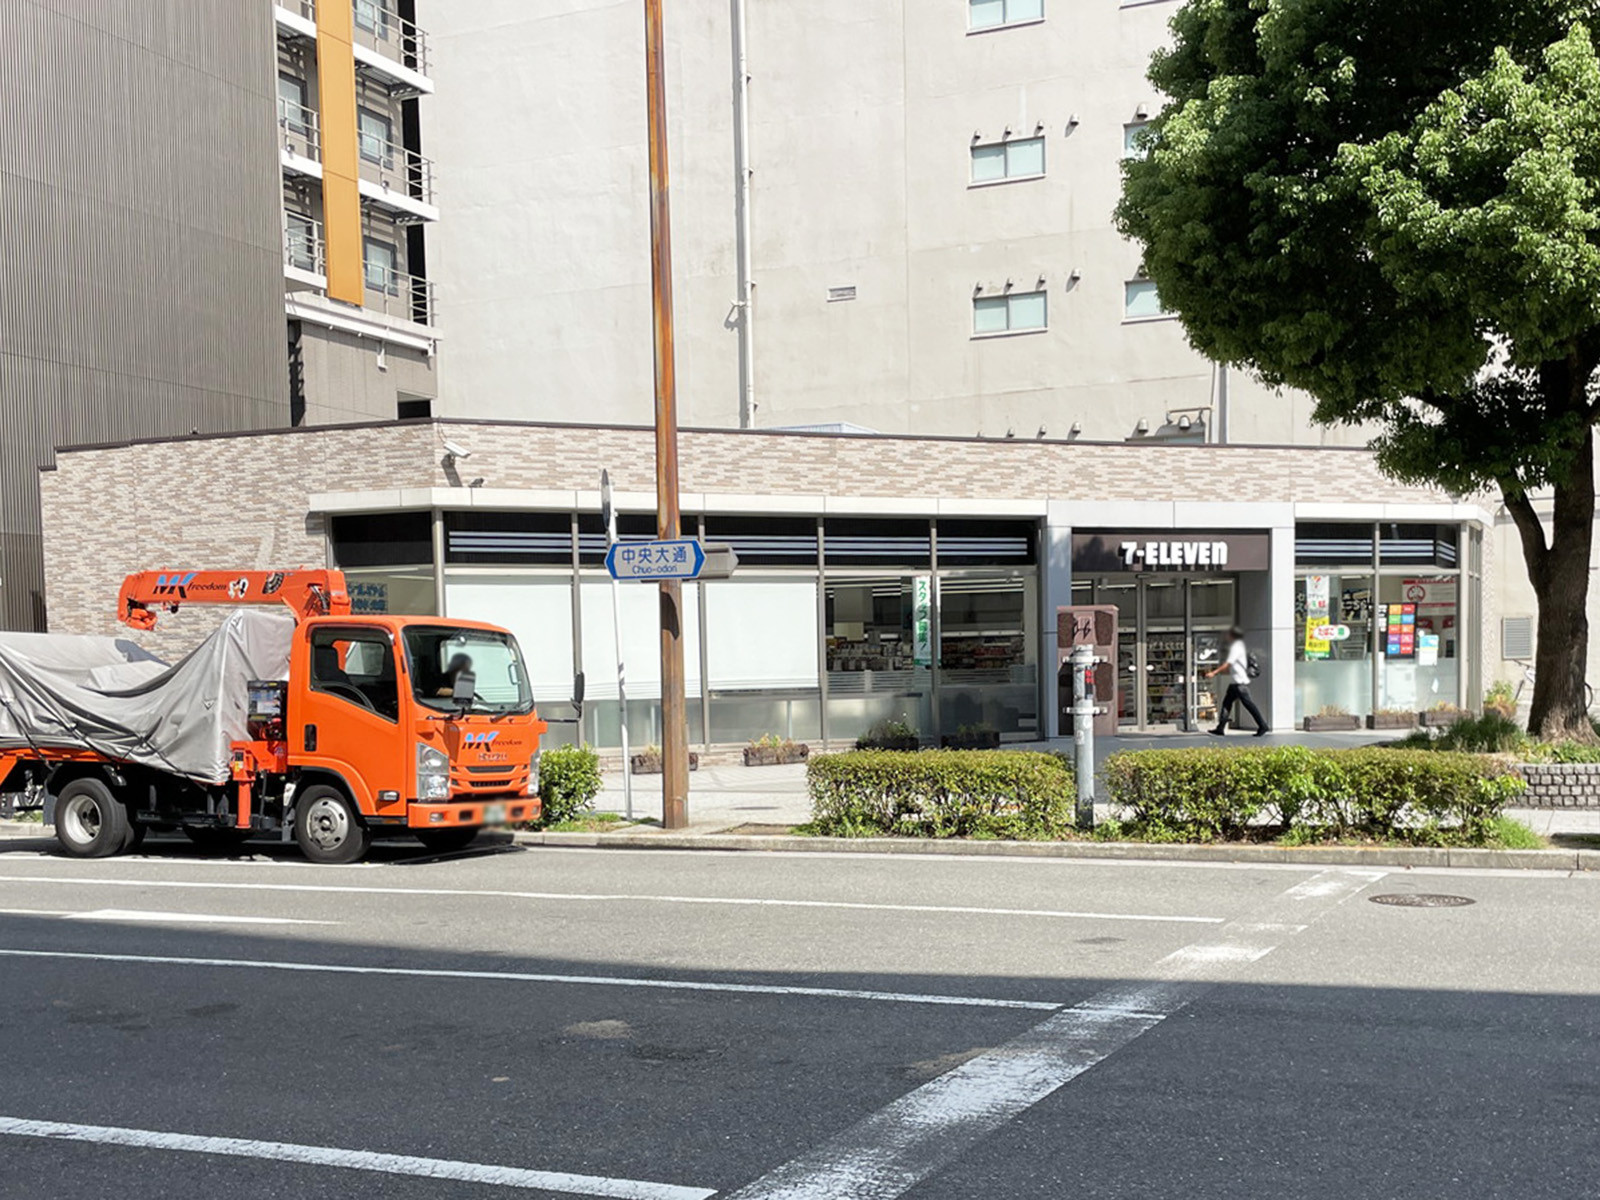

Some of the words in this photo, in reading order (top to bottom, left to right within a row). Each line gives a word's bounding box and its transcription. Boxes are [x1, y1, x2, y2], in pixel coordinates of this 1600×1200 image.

[621, 546, 687, 565] 中央大通
[187, 581, 227, 592] freedom
